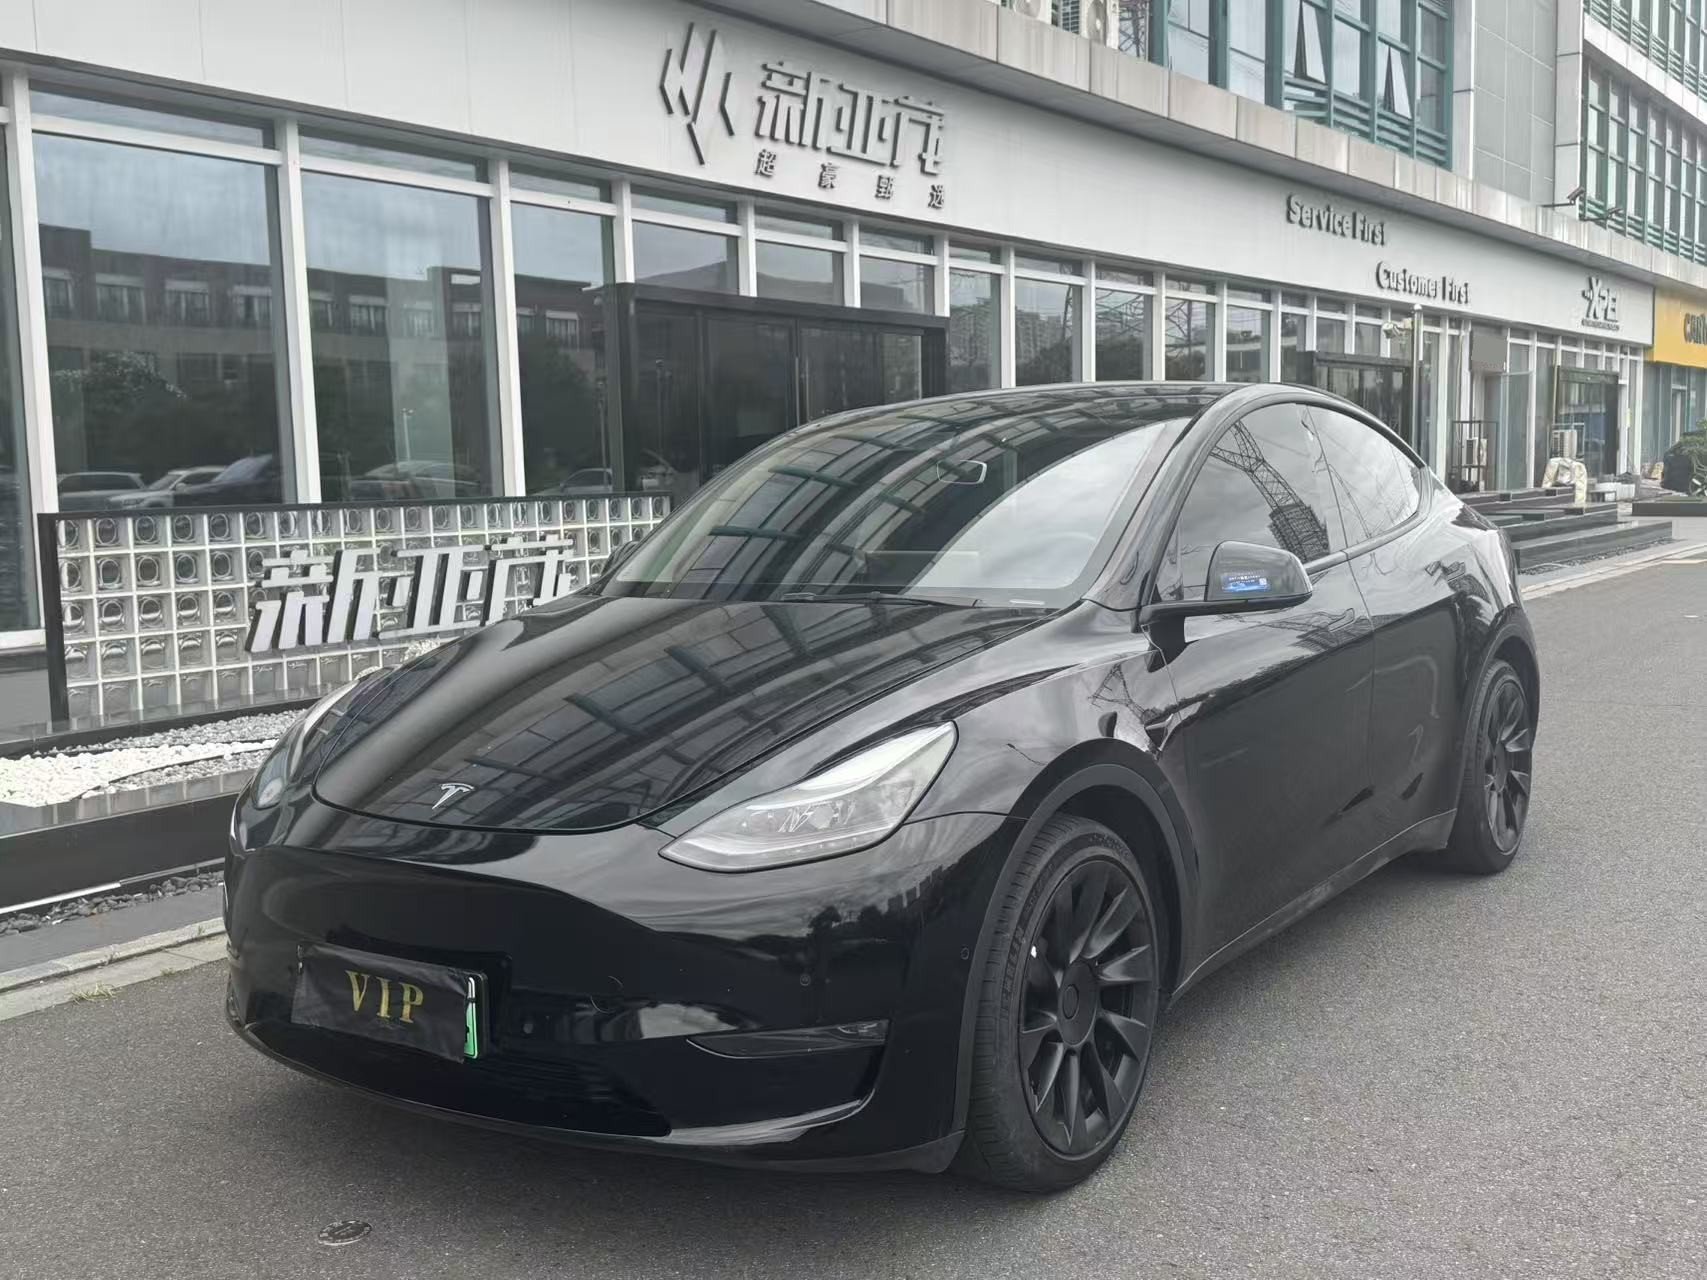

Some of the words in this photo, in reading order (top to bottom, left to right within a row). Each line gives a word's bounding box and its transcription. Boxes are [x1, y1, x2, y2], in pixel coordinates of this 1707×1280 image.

[1286, 192, 1351, 238] Service
[1352, 211, 1385, 246] First
[1376, 260, 1438, 300] Customer
[1441, 275, 1470, 304] First
[345, 969, 424, 1024] VIP
